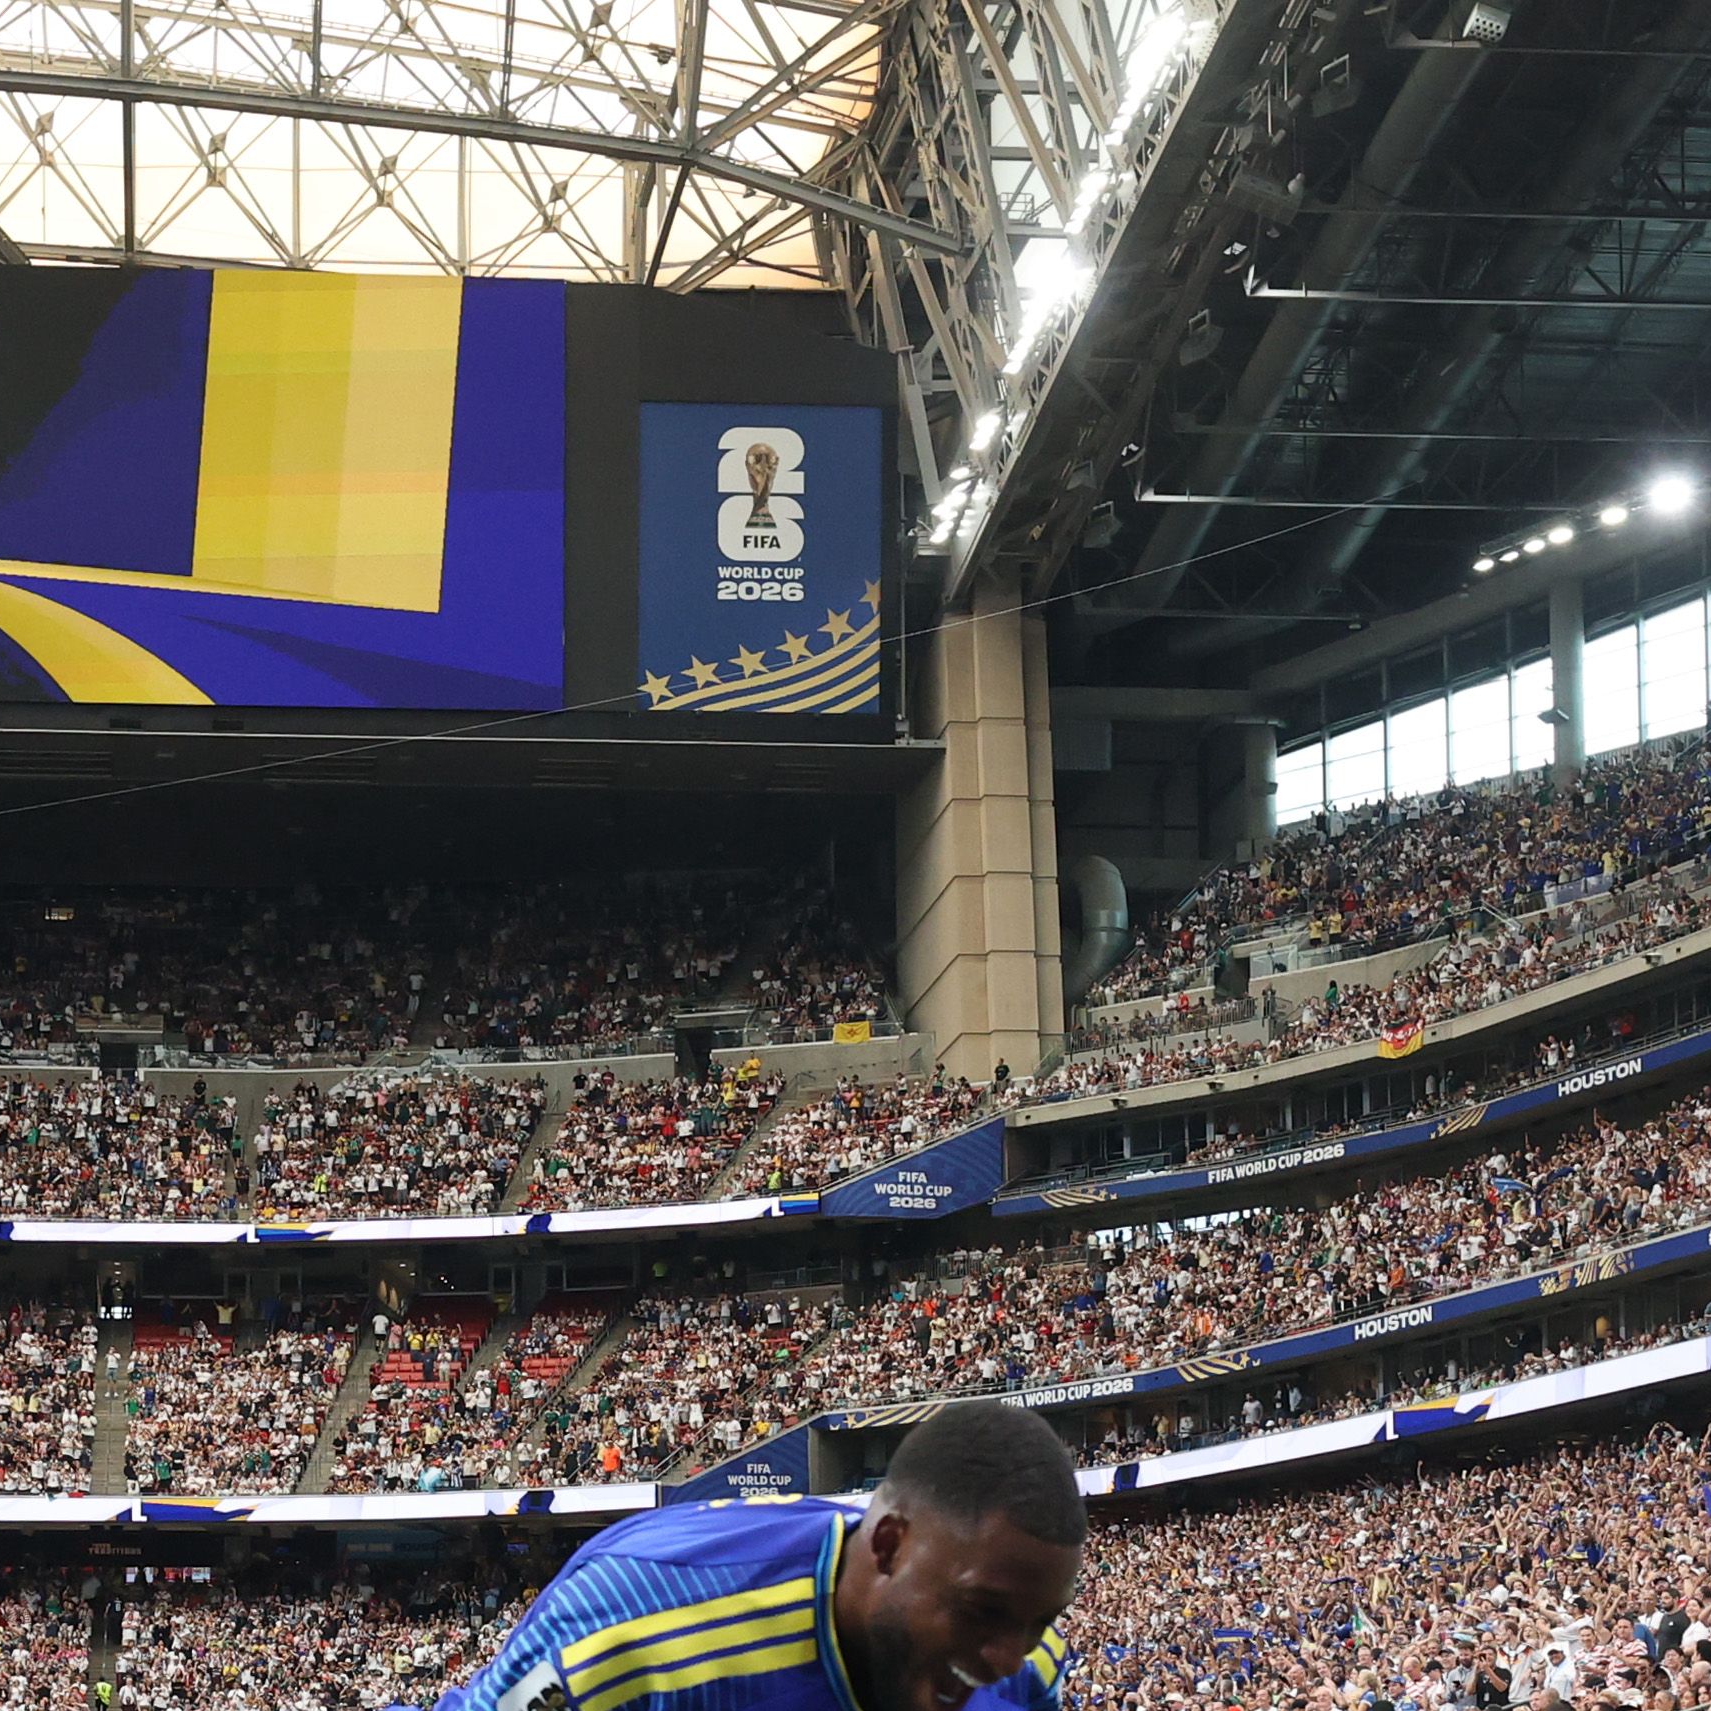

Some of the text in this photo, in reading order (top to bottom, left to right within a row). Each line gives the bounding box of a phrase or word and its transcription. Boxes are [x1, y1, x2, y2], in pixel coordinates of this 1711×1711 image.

[742, 535, 781, 549] FIFA
[717, 567, 804, 580] WORLD CUP
[717, 581, 805, 601] 2026
[1558, 1058, 1642, 1097] HOUSTON
[1208, 1143, 1345, 1184] FIFA WORLD CUP 2026
[898, 1172, 928, 1184] FIFA
[874, 1183, 952, 1197] WORLD CUP
[889, 1197, 937, 1209] 2026
[1354, 1306, 1433, 1340] HOUSTON
[1025, 1388, 1066, 1408] WORLD
[1068, 1384, 1091, 1401] CUP
[1092, 1378, 1134, 1396] 2026
[747, 1464, 771, 1474] FIFA
[727, 1475, 791, 1486] WORLD CUP
